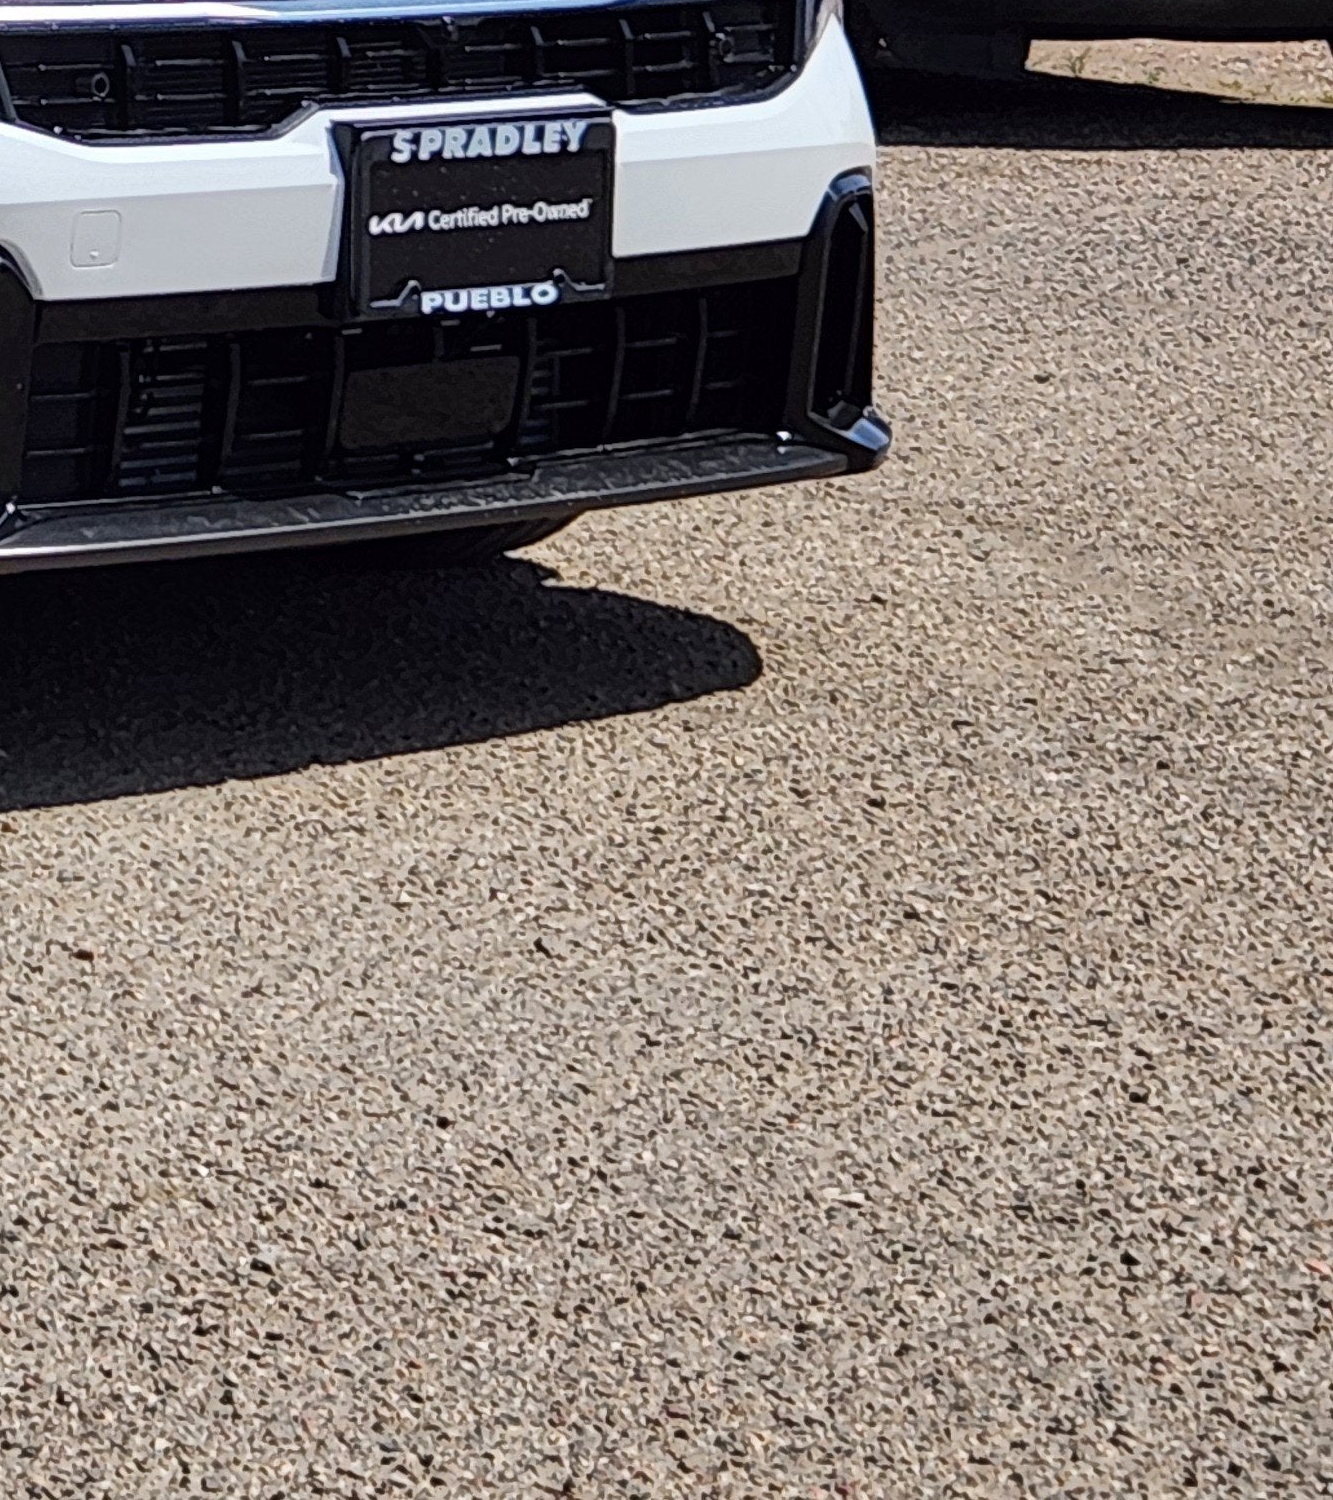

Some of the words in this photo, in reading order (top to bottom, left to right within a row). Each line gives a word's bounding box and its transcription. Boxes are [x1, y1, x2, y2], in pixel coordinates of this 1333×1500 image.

[390, 121, 588, 164] SPRADLEY
[427, 205, 500, 231] Certified
[501, 199, 591, 225] Pre-Owned
[420, 282, 559, 315] PUEBLO
